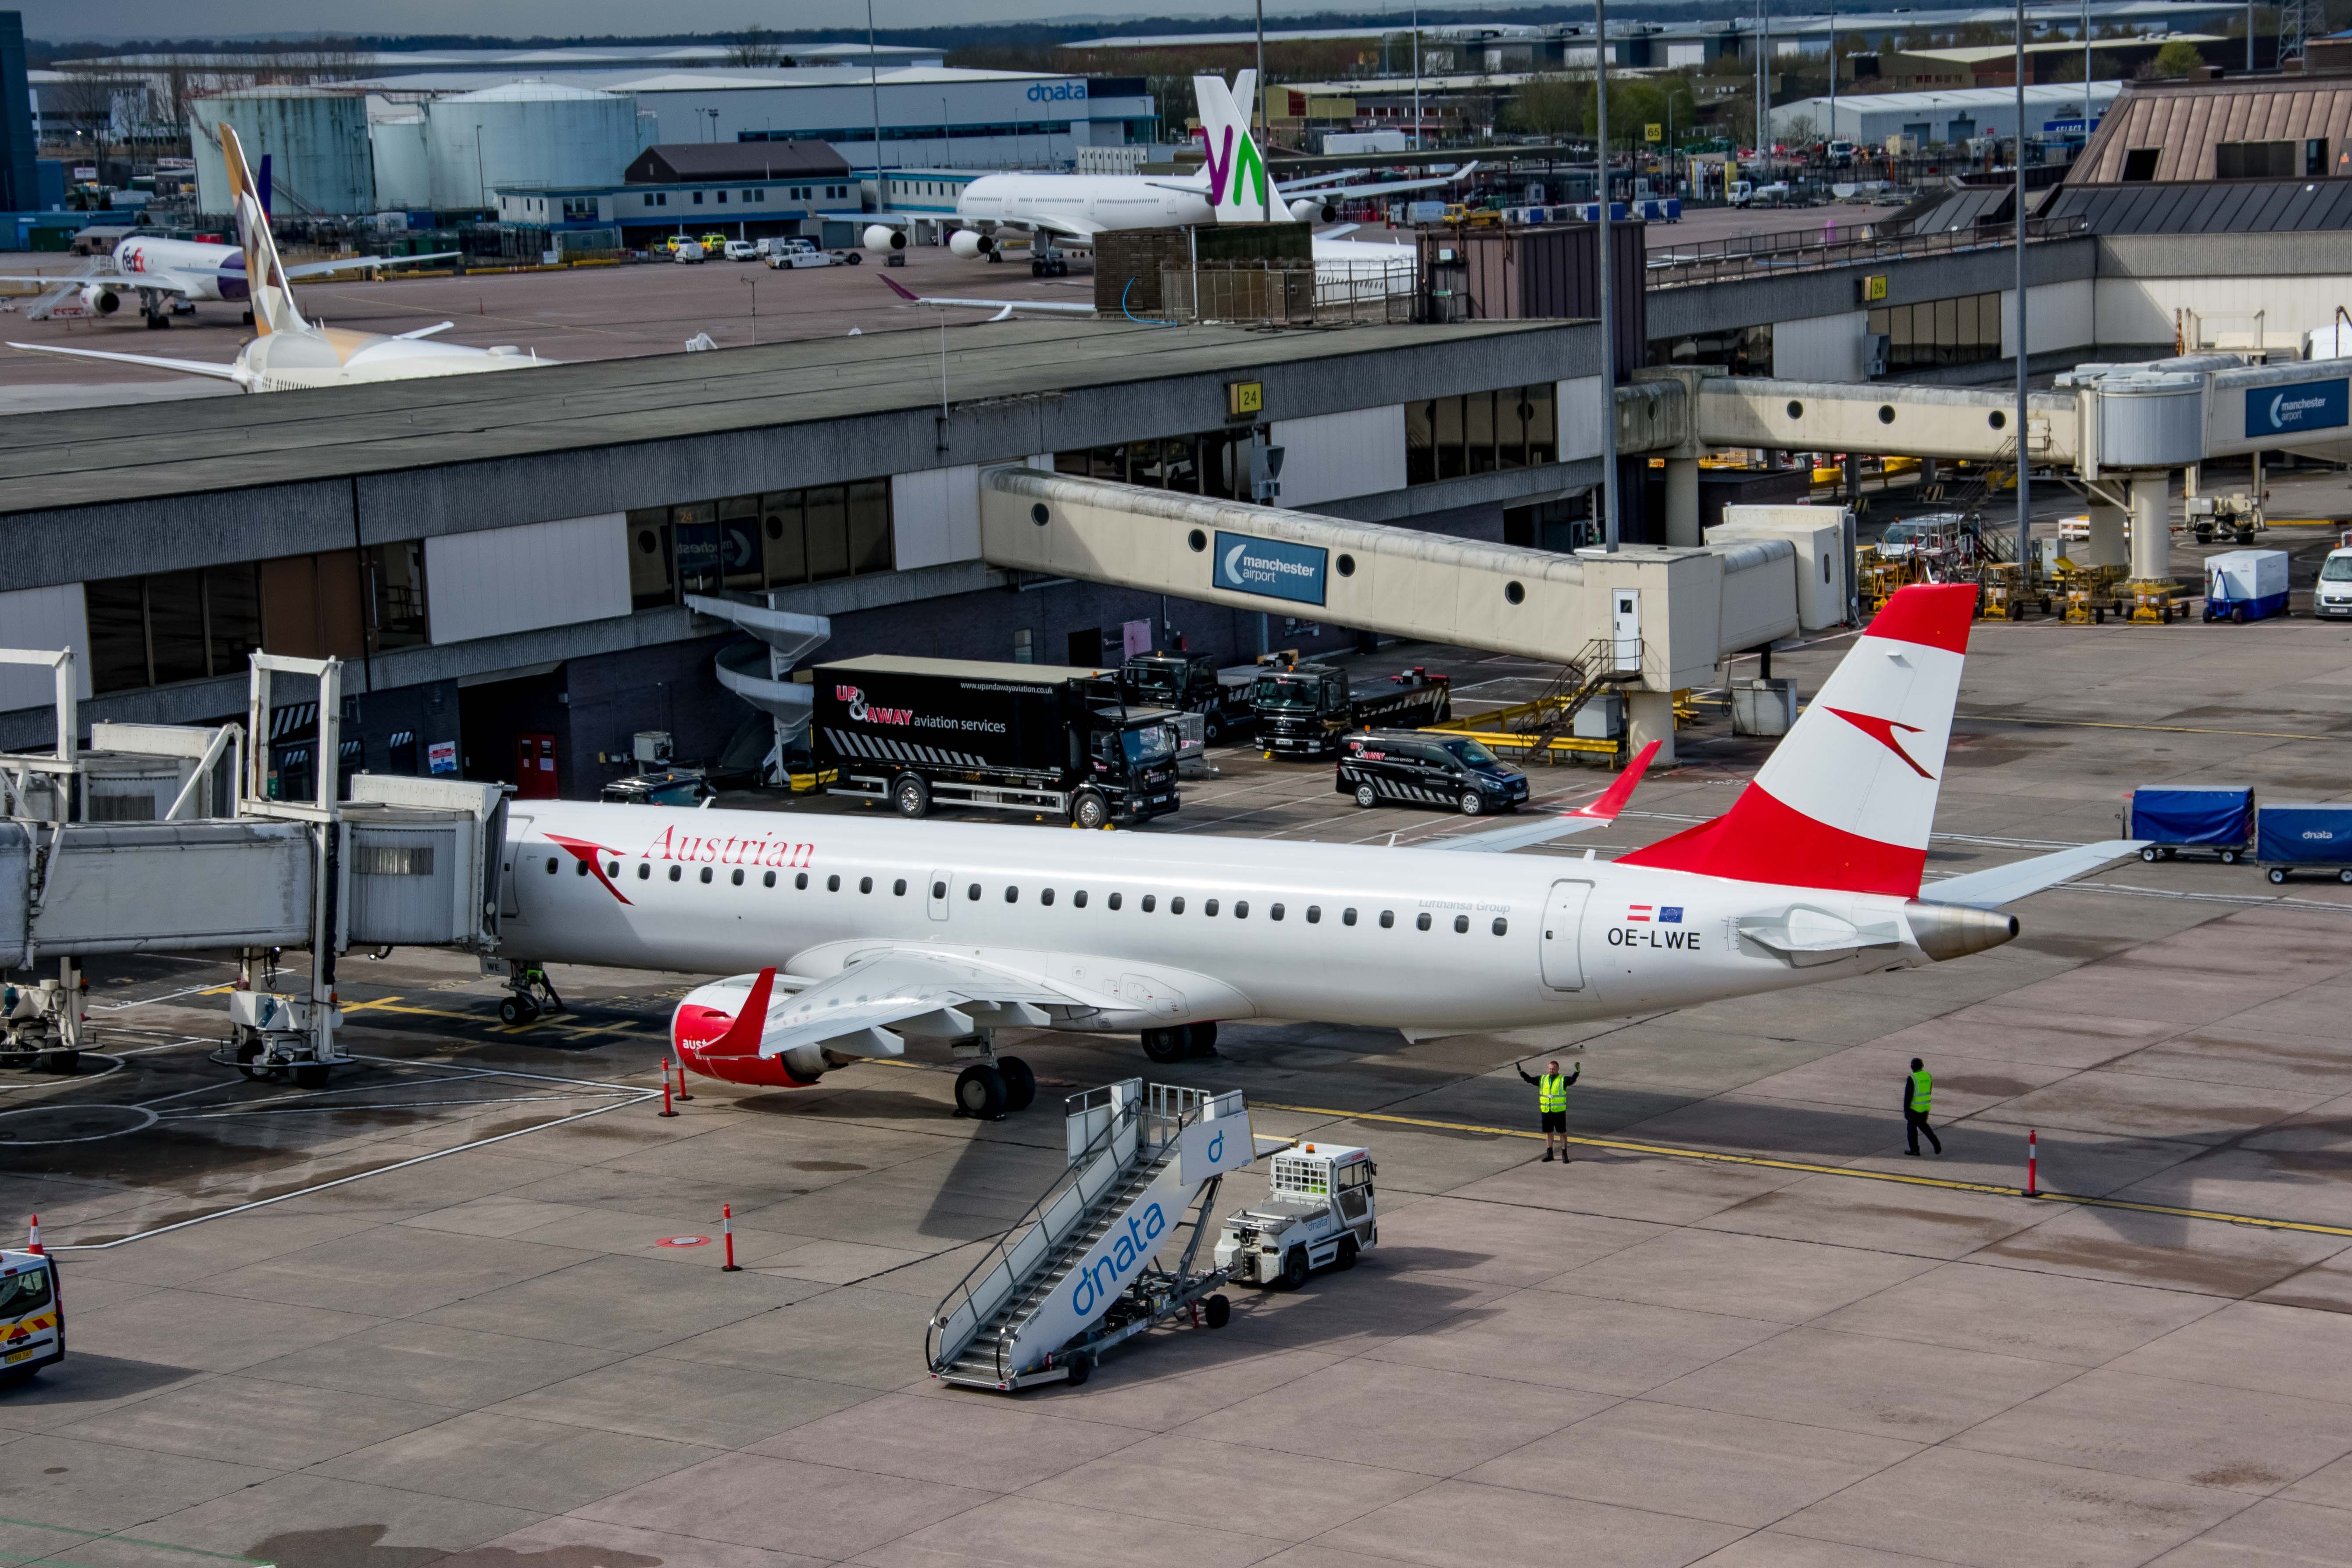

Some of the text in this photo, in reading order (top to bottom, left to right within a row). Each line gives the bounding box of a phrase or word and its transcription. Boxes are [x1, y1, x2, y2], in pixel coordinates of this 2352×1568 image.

[1027, 82, 1086, 101] dnata
[1648, 128, 1660, 136] 65
[122, 246, 146, 273] FedEx
[1875, 282, 1883, 294] 26
[1243, 390, 1257, 405] 24
[2281, 397, 2326, 411] manchester
[2281, 410, 2302, 422] airport
[1243, 556, 1315, 577] manchester
[1243, 567, 1276, 583] airport
[836, 685, 858, 702] UP
[960, 682, 1053, 695] www.upandawayaviation.co.uk
[849, 689, 869, 721] &
[866, 707, 1006, 733] AWAY aviation services
[1350, 742, 1361, 750] UP
[1363, 751, 1386, 760] AWAY
[2302, 831, 2333, 839] dnata
[641, 825, 815, 868] Austrian
[1419, 899, 1511, 914] Lufthansa Group
[1608, 927, 1701, 950] OE-LWE
[487, 963, 500, 971] WE
[1308, 1218, 1328, 1232] dnata
[1073, 1202, 1165, 1317] dnata
[1028, 1310, 1041, 1325] DTS04
